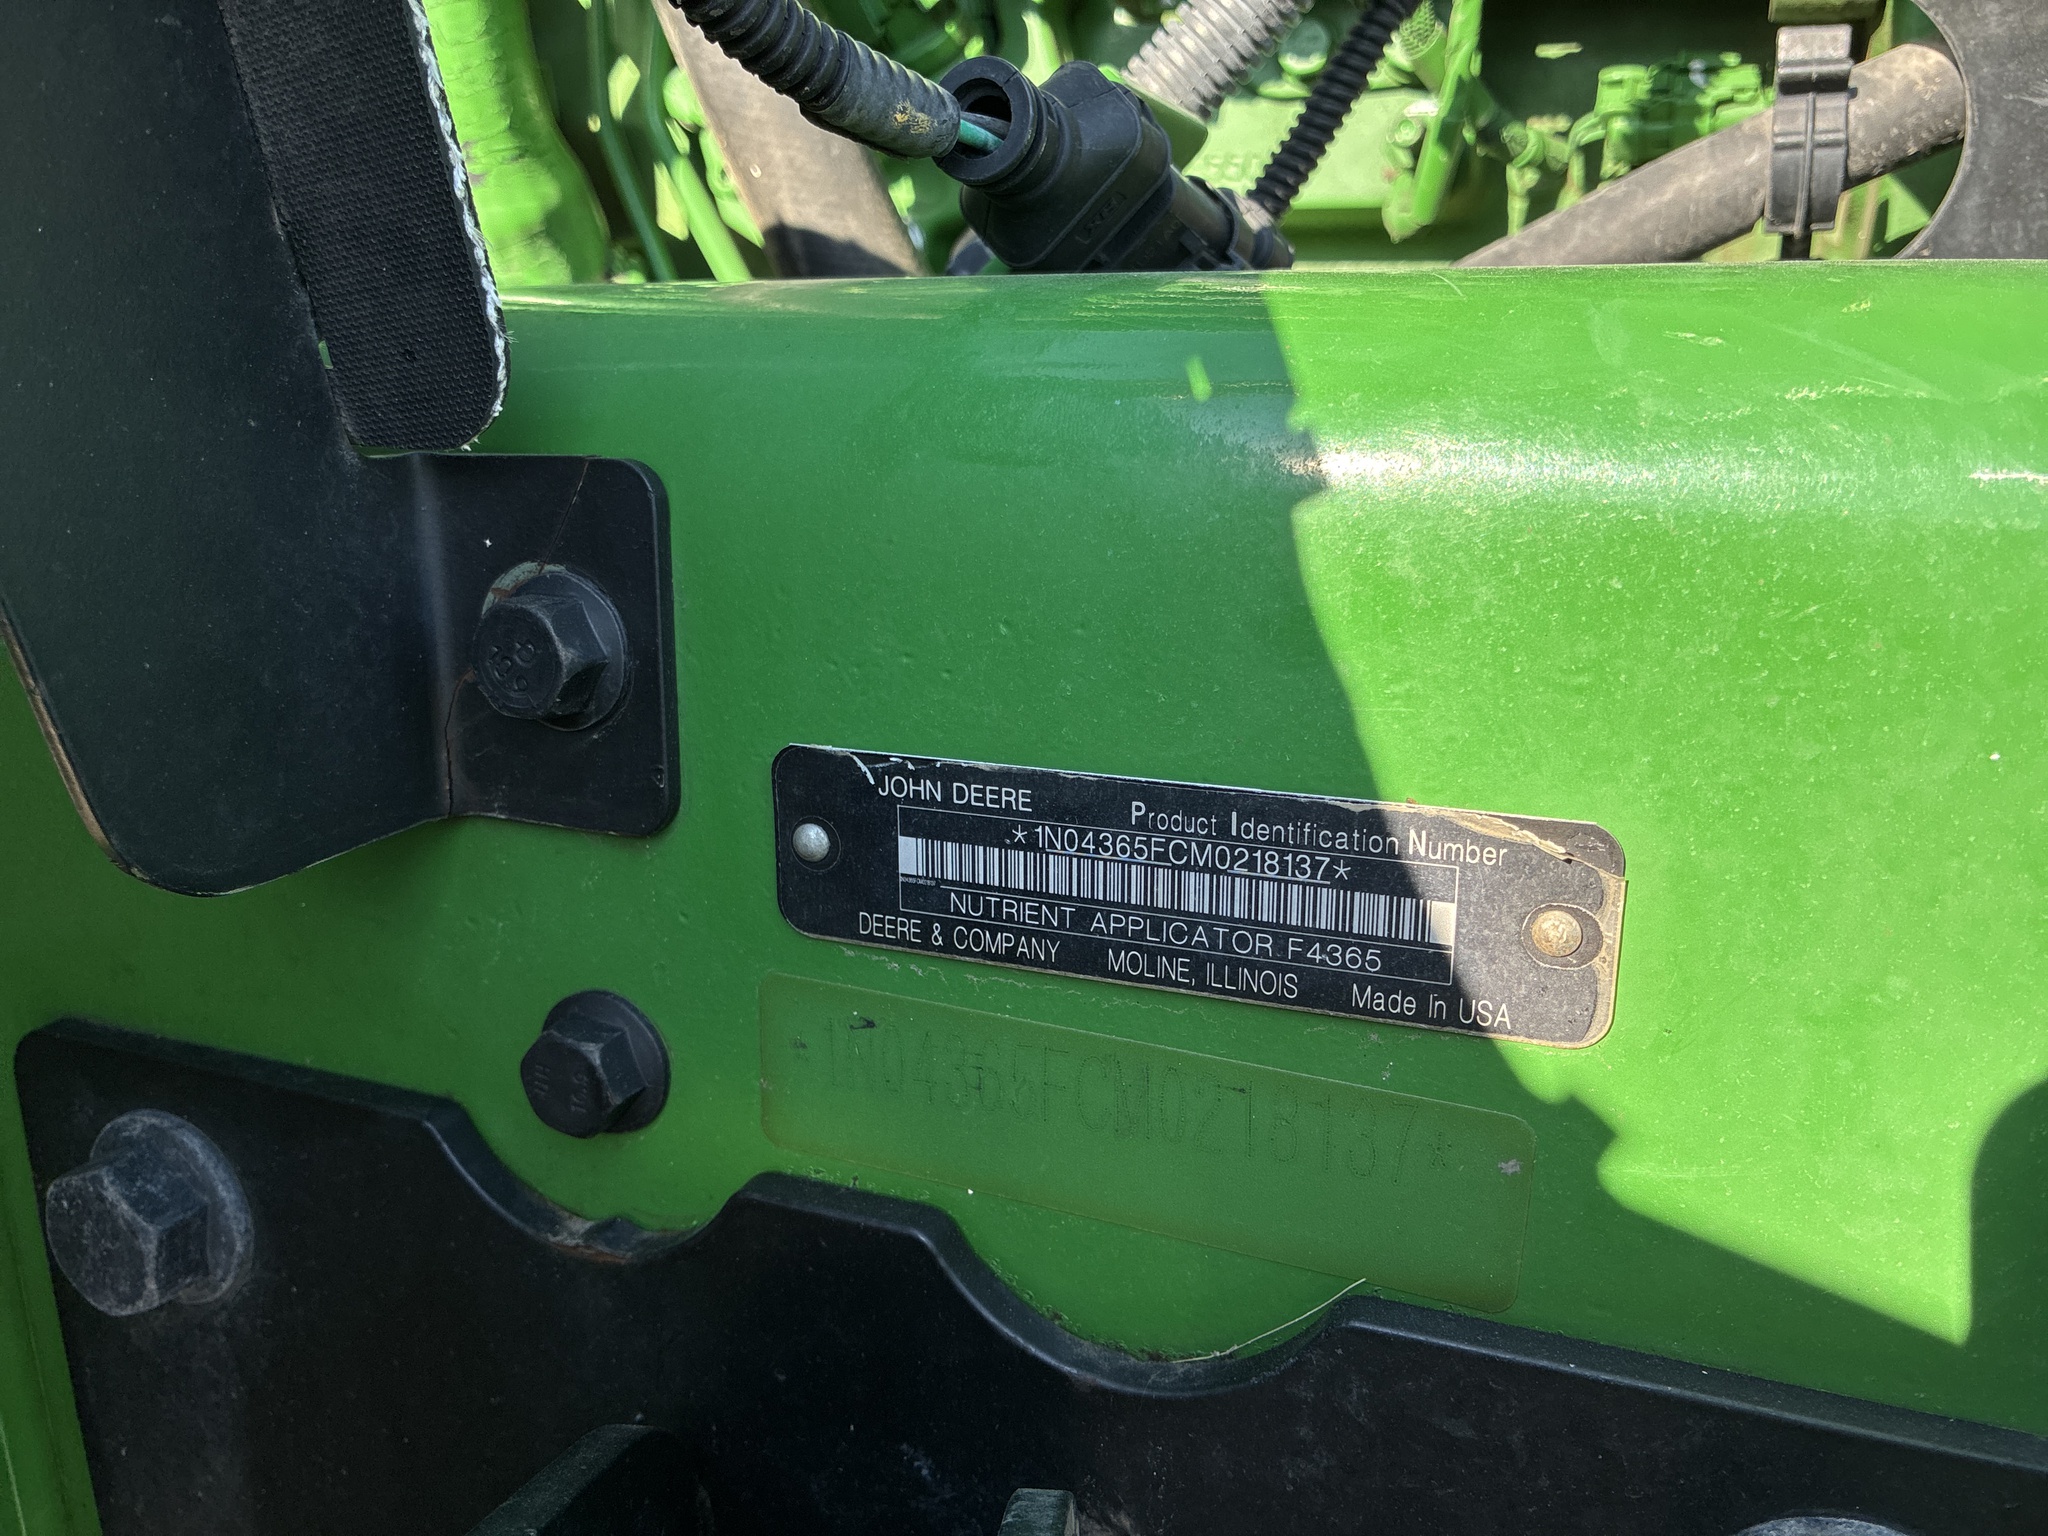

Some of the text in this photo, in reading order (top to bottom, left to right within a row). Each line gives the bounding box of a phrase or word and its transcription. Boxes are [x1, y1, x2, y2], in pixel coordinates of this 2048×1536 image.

[878, 775, 1033, 812] JOHN DEERE
[1131, 801, 1508, 866] Product Identification Number
[859, 912, 1060, 963] DEERE & COMPANY
[950, 892, 1382, 972] NUTRIENT APPLICATOR F4365
[1108, 948, 1298, 999] MOLINE, ILLINOIS
[1352, 983, 1511, 1030] Made In USA
